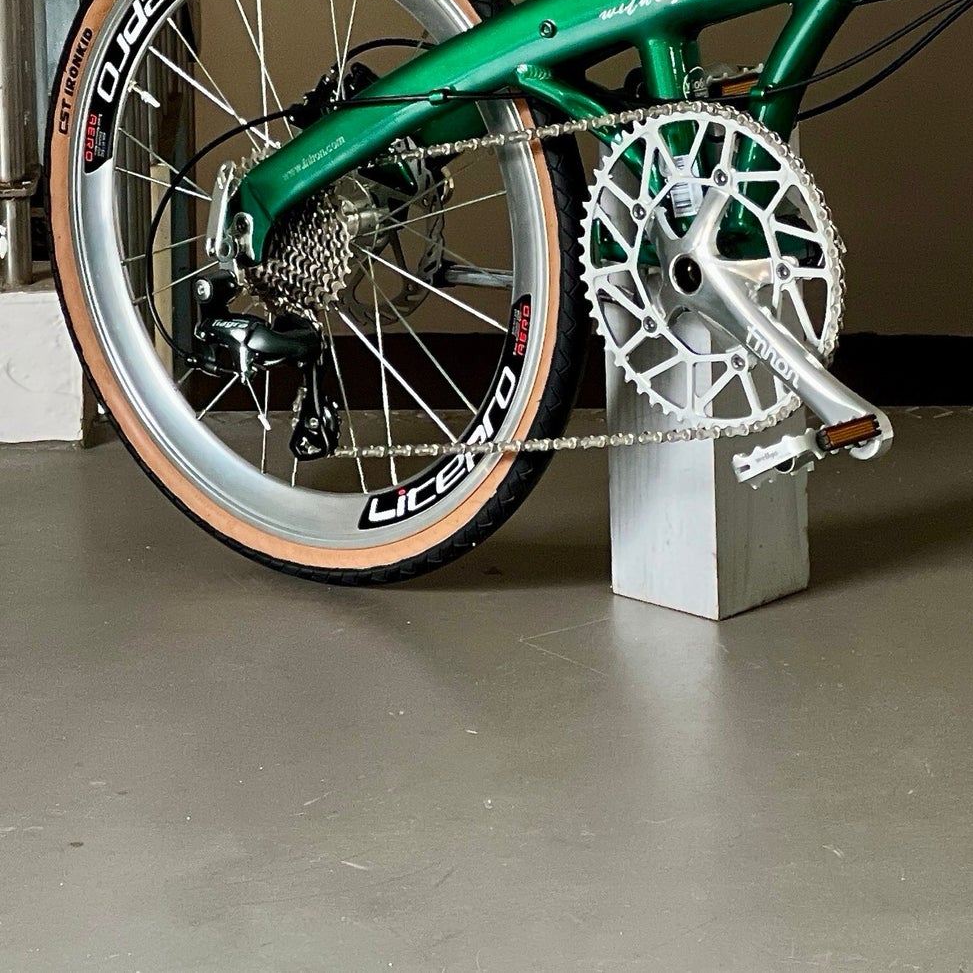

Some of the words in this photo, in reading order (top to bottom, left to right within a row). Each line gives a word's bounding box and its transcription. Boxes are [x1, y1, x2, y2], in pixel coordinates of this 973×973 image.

[64, 27, 93, 96] IRONKID
[58, 98, 72, 135] CST
[85, 113, 98, 162] AERO
